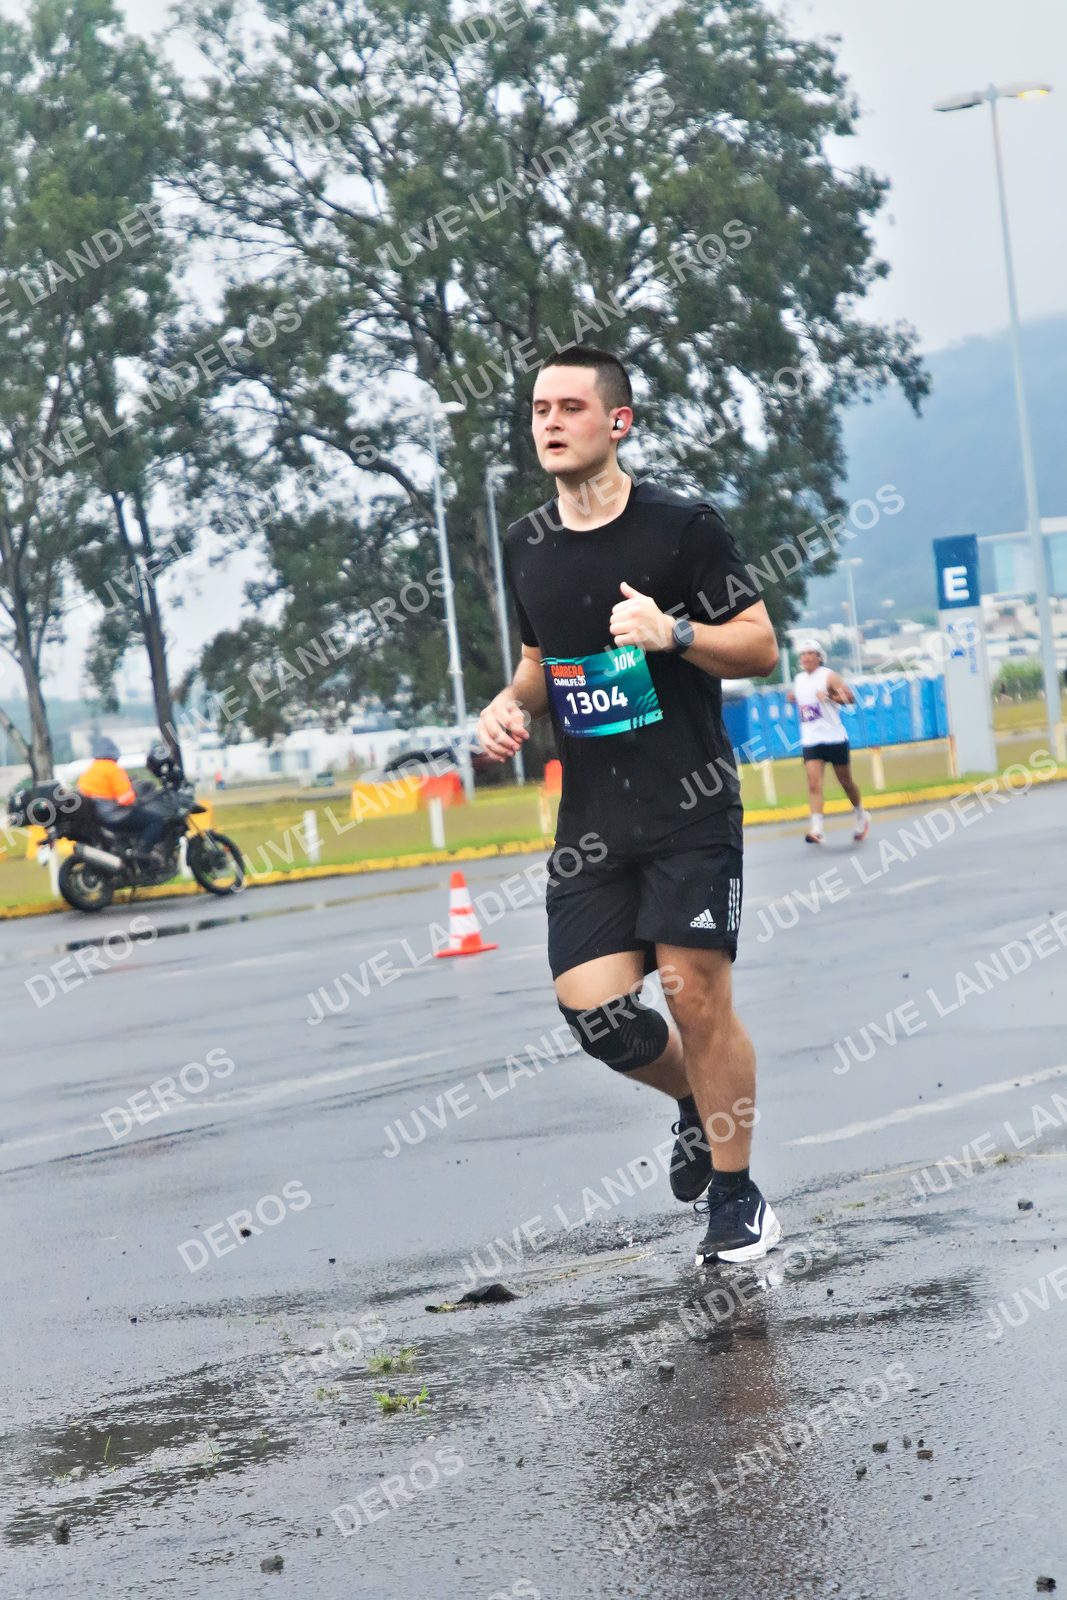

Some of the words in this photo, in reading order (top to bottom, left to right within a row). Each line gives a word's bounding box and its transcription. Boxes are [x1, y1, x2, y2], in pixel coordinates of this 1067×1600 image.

[943, 566, 970, 601] E
[613, 651, 637, 672] 10K
[566, 686, 628, 715] 1304
[690, 920, 717, 929] adidas
